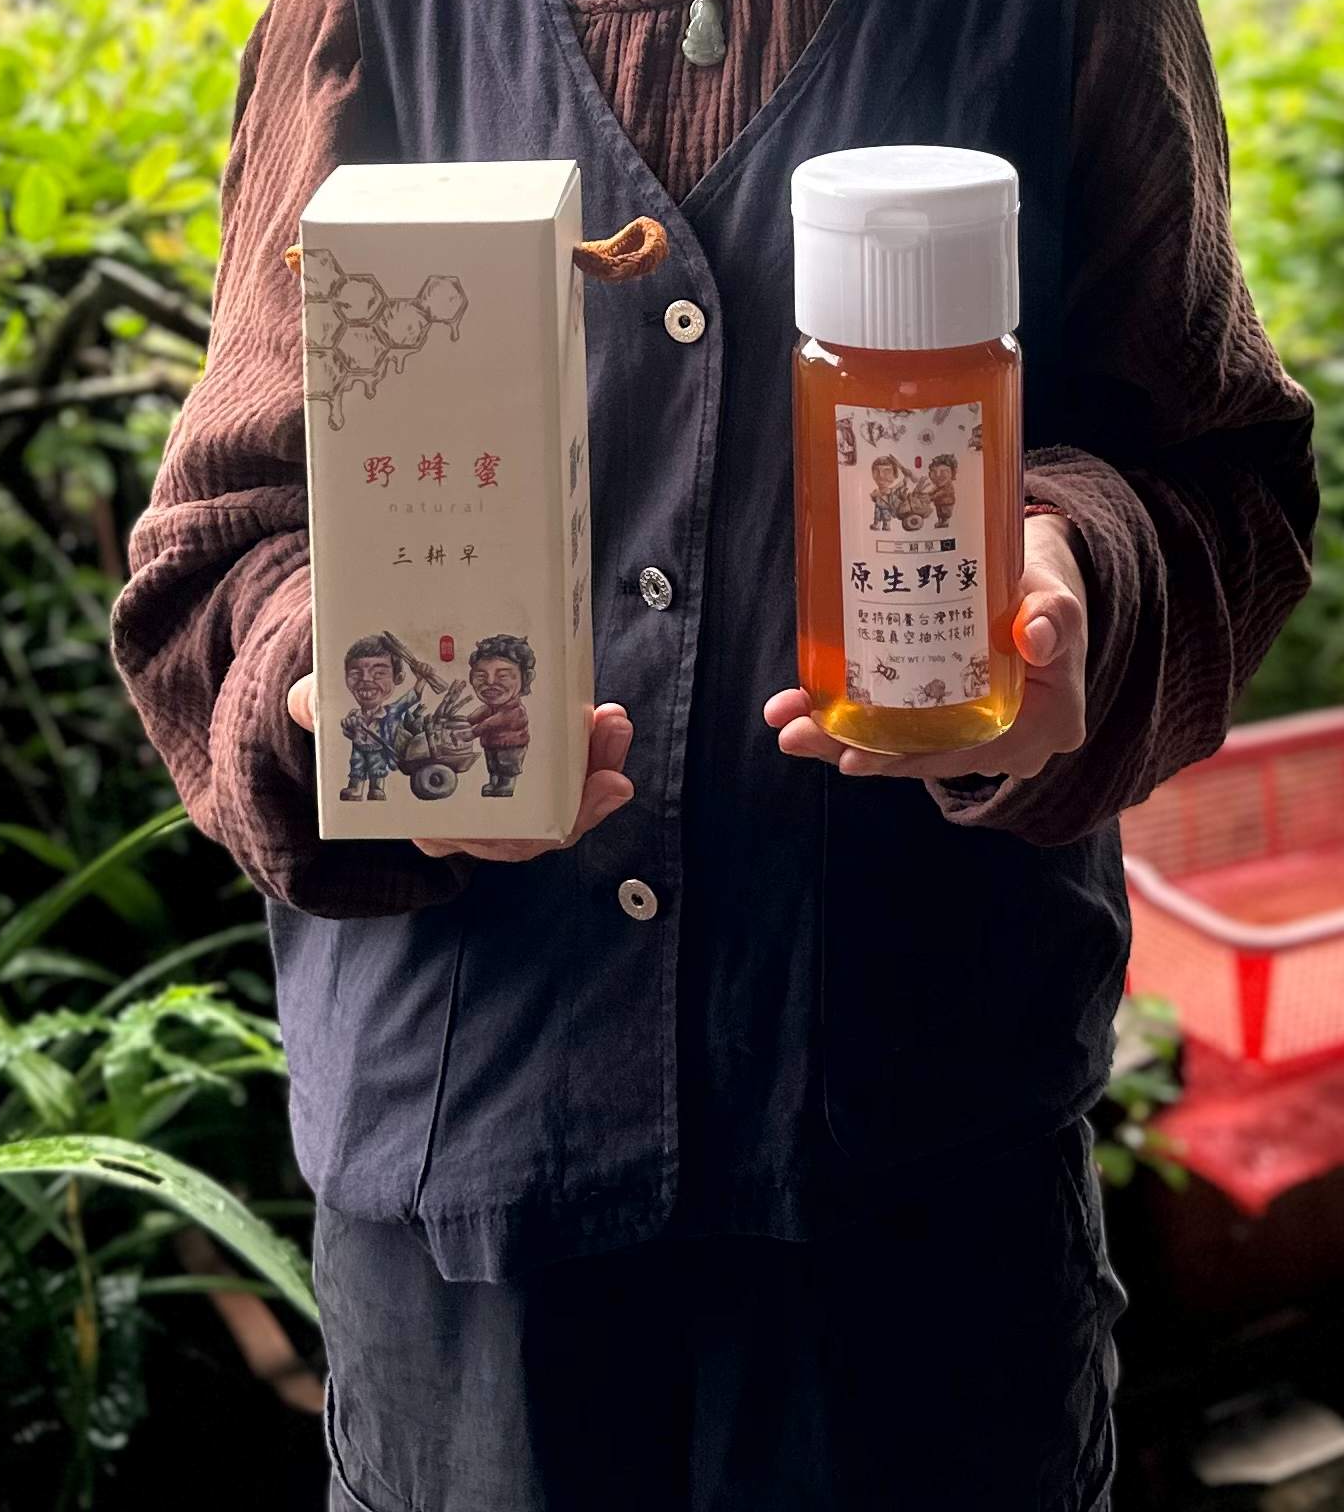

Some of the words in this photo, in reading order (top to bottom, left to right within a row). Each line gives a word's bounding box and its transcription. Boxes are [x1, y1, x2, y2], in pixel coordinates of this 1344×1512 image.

[363, 452, 502, 488] 野蜂蜜
[389, 499, 484, 513] natural
[392, 544, 479, 566] 三耕早
[851, 558, 978, 594] 原生野蜜
